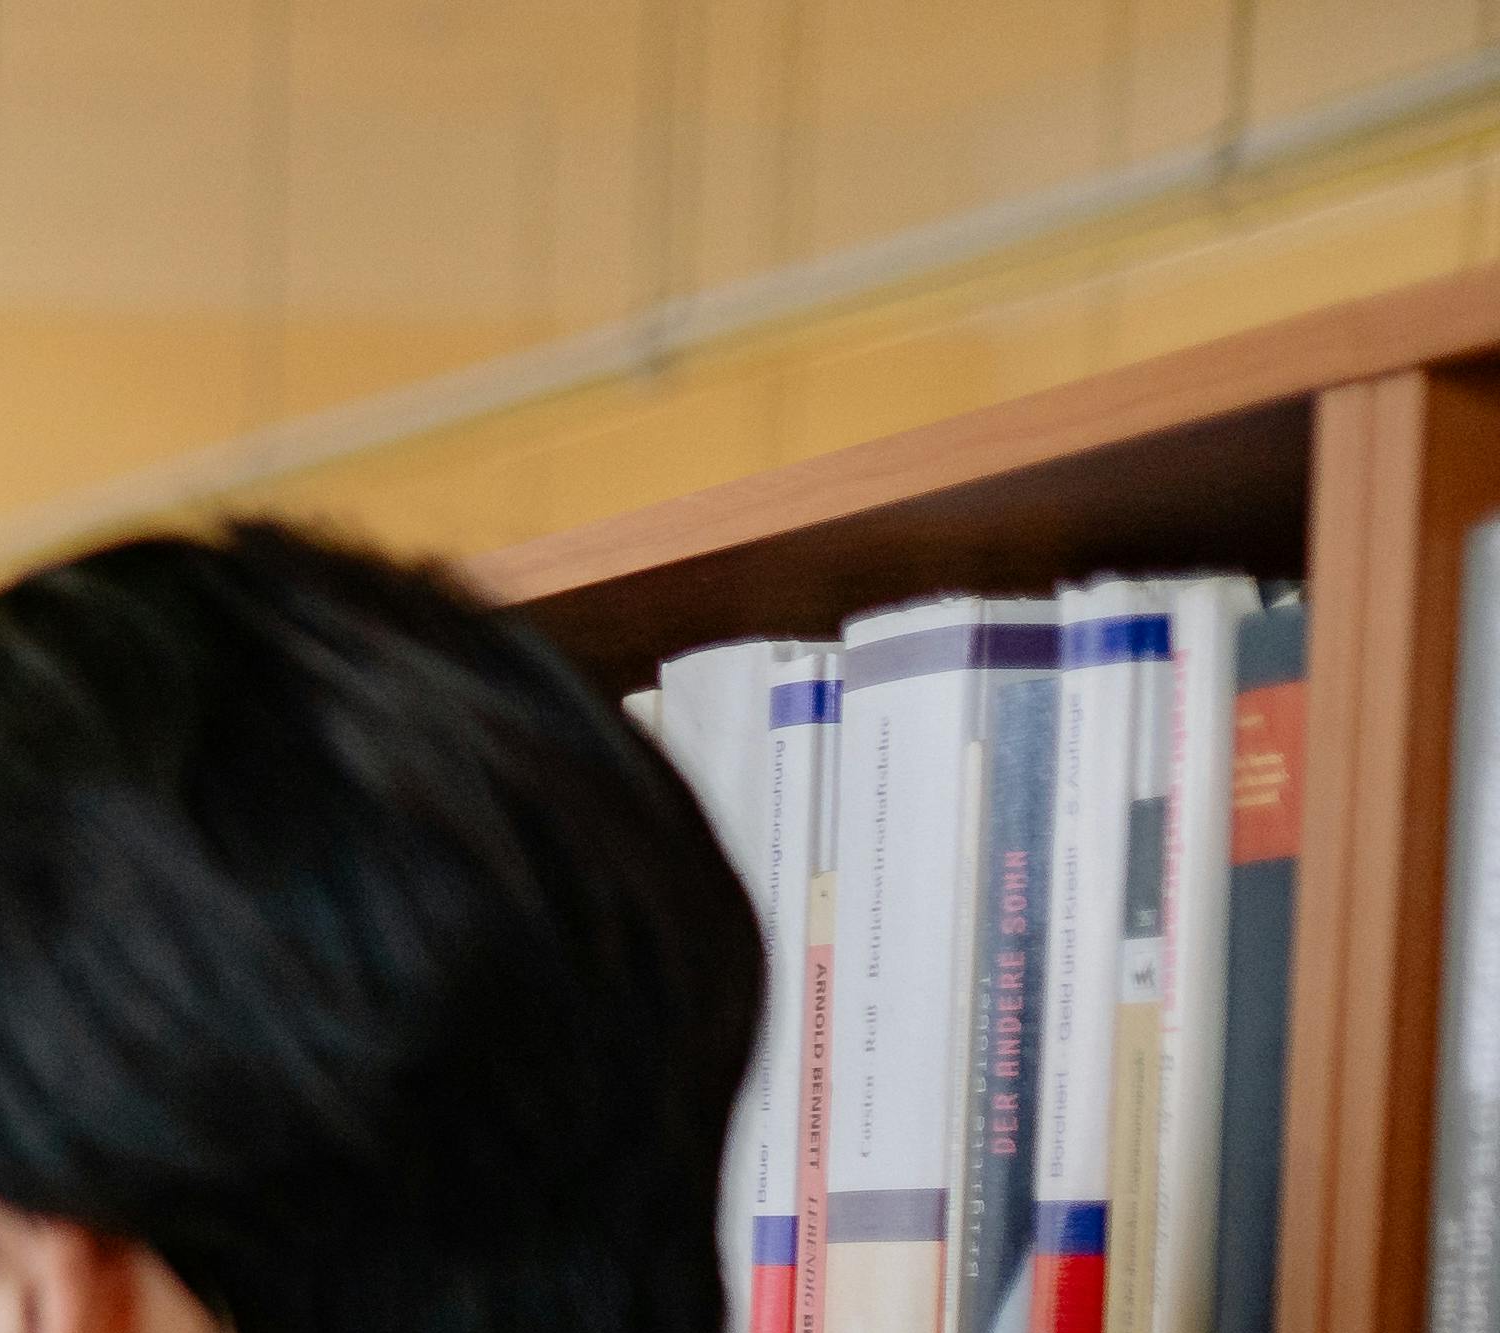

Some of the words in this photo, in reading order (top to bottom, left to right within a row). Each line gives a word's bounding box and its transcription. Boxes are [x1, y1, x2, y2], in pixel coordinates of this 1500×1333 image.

[1065, 693, 1083, 791] Auflage
[865, 715, 891, 979] Betriebswirtschaftslehre
[1000, 849, 1029, 936] SOHN
[1060, 846, 1079, 920] Kredit
[1058, 928, 1077, 975] und
[810, 961, 829, 1060] ARNOLD
[994, 951, 1025, 1079] ANDERE
[1055, 982, 1075, 1041] Geld
[808, 1066, 825, 1170] BENNETT
[991, 1093, 1021, 1157] DER
[755, 1143, 770, 1204] Bauer
[802, 1194, 819, 1308] LEBENDIG
